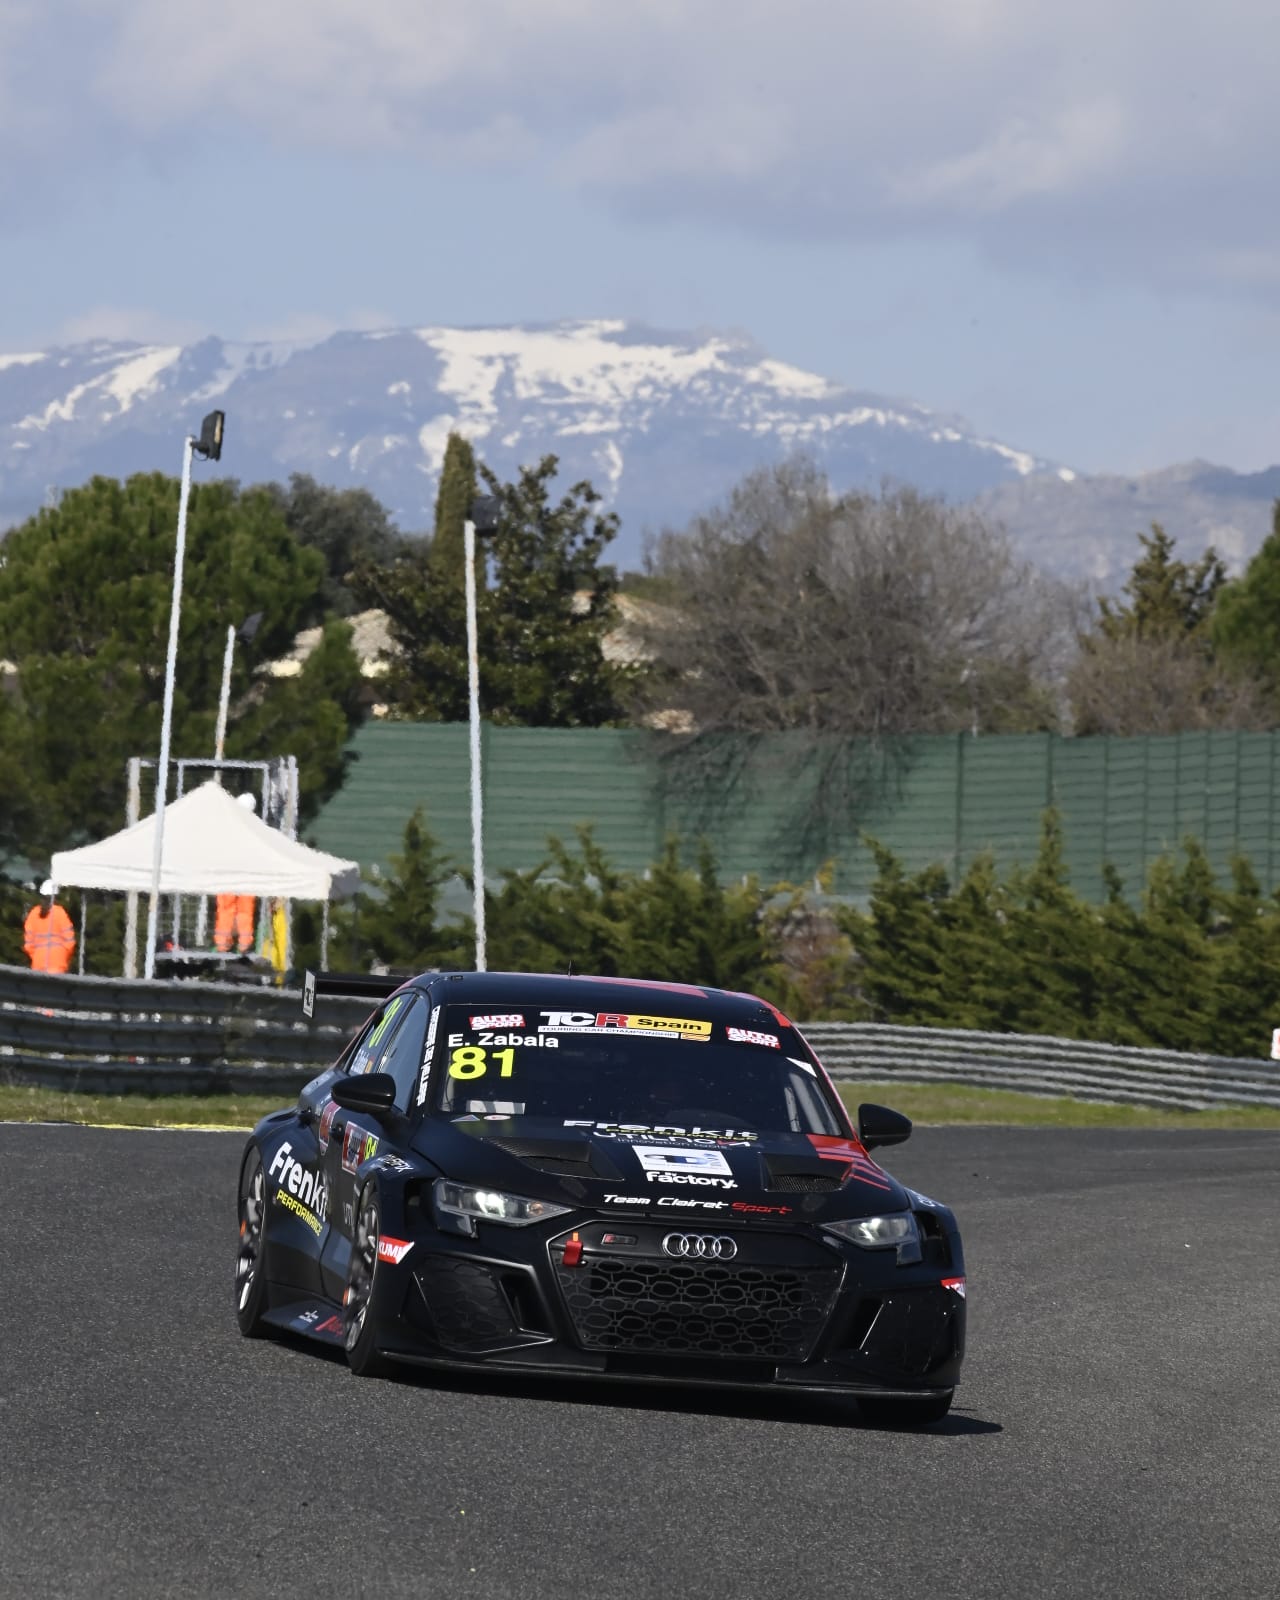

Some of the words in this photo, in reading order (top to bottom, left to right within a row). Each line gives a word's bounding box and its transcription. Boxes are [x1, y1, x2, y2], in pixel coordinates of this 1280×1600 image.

[540, 1011, 629, 1028] TCR
[637, 1018, 702, 1031] Spain
[448, 1034, 471, 1048] E.
[478, 1032, 559, 1048] Zabala
[448, 1046, 515, 1080] 81
[603, 1194, 651, 1206] Team
[730, 1201, 793, 1215] Sport
